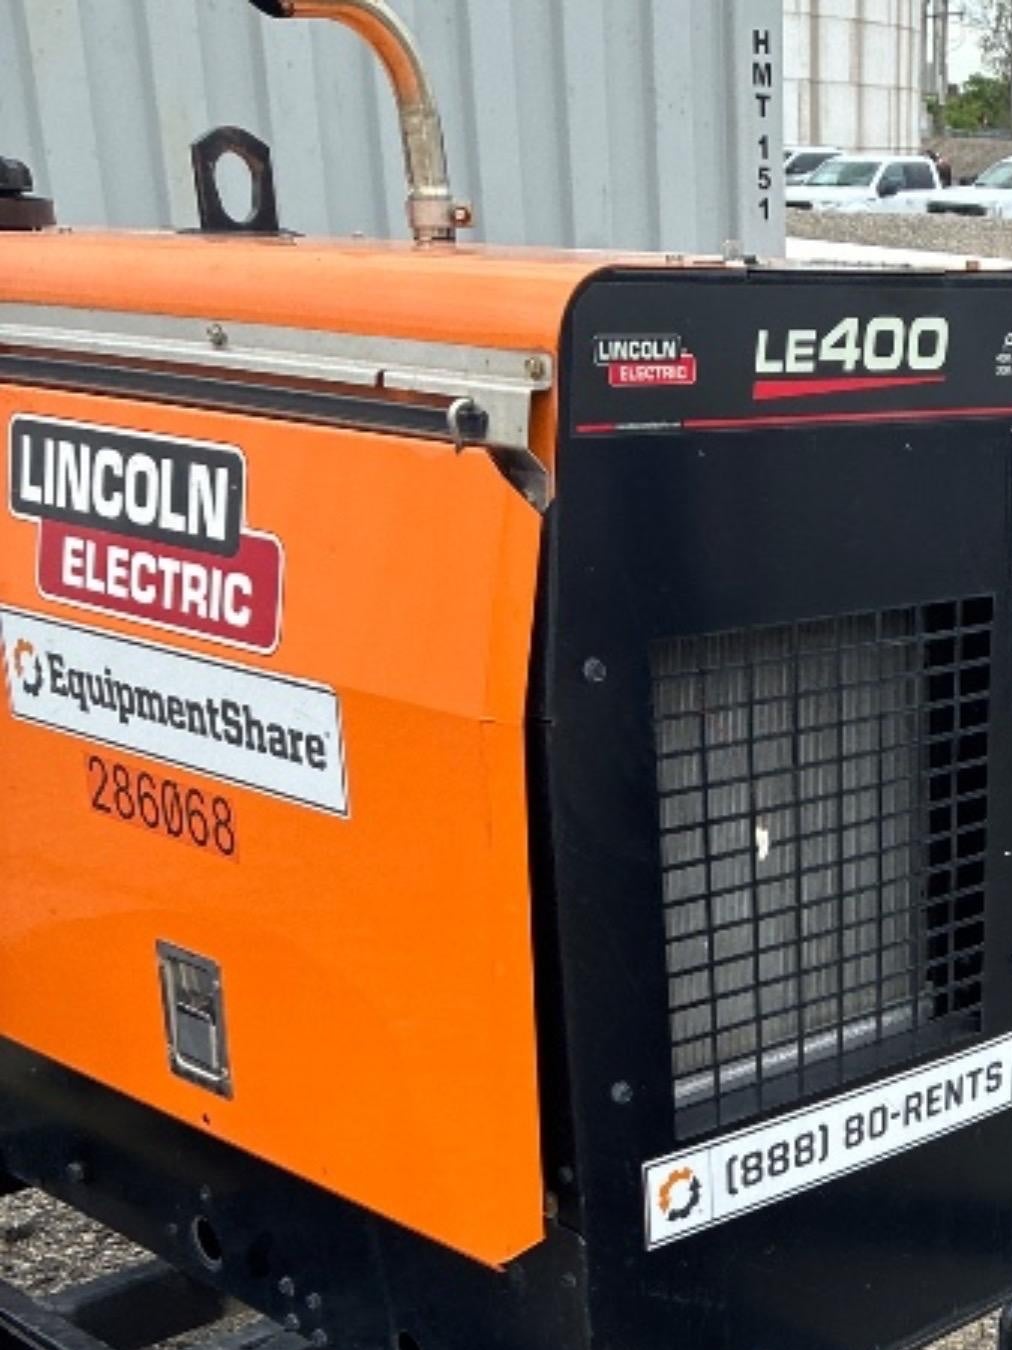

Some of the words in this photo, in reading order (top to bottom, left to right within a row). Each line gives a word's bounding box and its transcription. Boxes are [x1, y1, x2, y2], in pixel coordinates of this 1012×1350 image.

[758, 134, 772, 220] 151
[598, 340, 677, 361] LINCOLN
[619, 365, 689, 382] ELECTRIC
[755, 316, 949, 373] LE400
[19, 434, 229, 541] LINCOLN
[62, 535, 253, 628] ELECTRIC
[46, 651, 328, 771] EquipmentShare
[88, 755, 236, 856] 286068
[725, 1123, 829, 1195] (888)
[844, 1061, 1004, 1150] 80-RENTS
